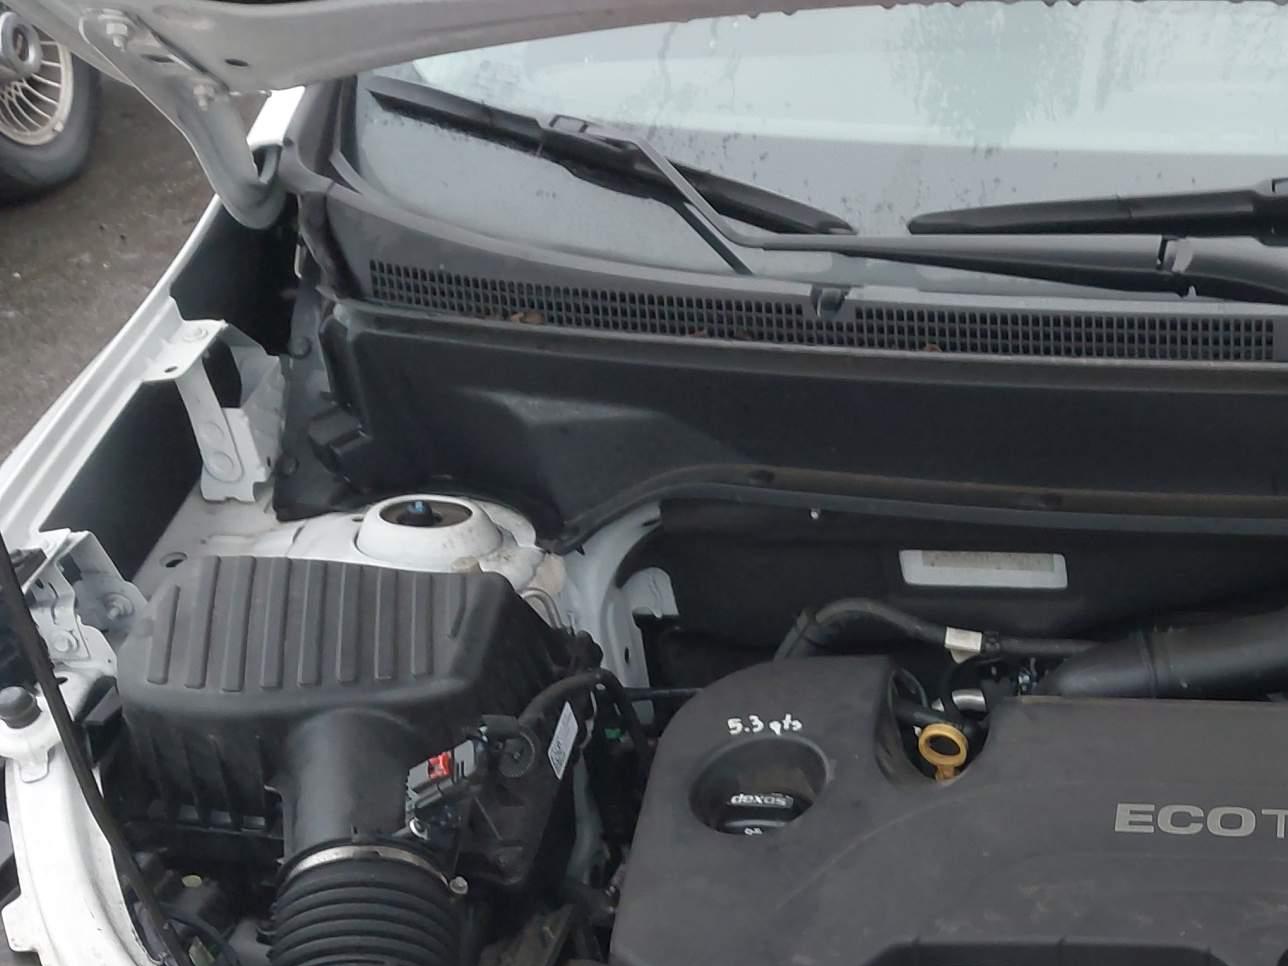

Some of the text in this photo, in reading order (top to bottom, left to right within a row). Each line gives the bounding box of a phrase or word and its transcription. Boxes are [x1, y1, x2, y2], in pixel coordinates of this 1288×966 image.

[727, 713, 802, 736] 5.3 qts
[730, 793, 787, 807] dexos
